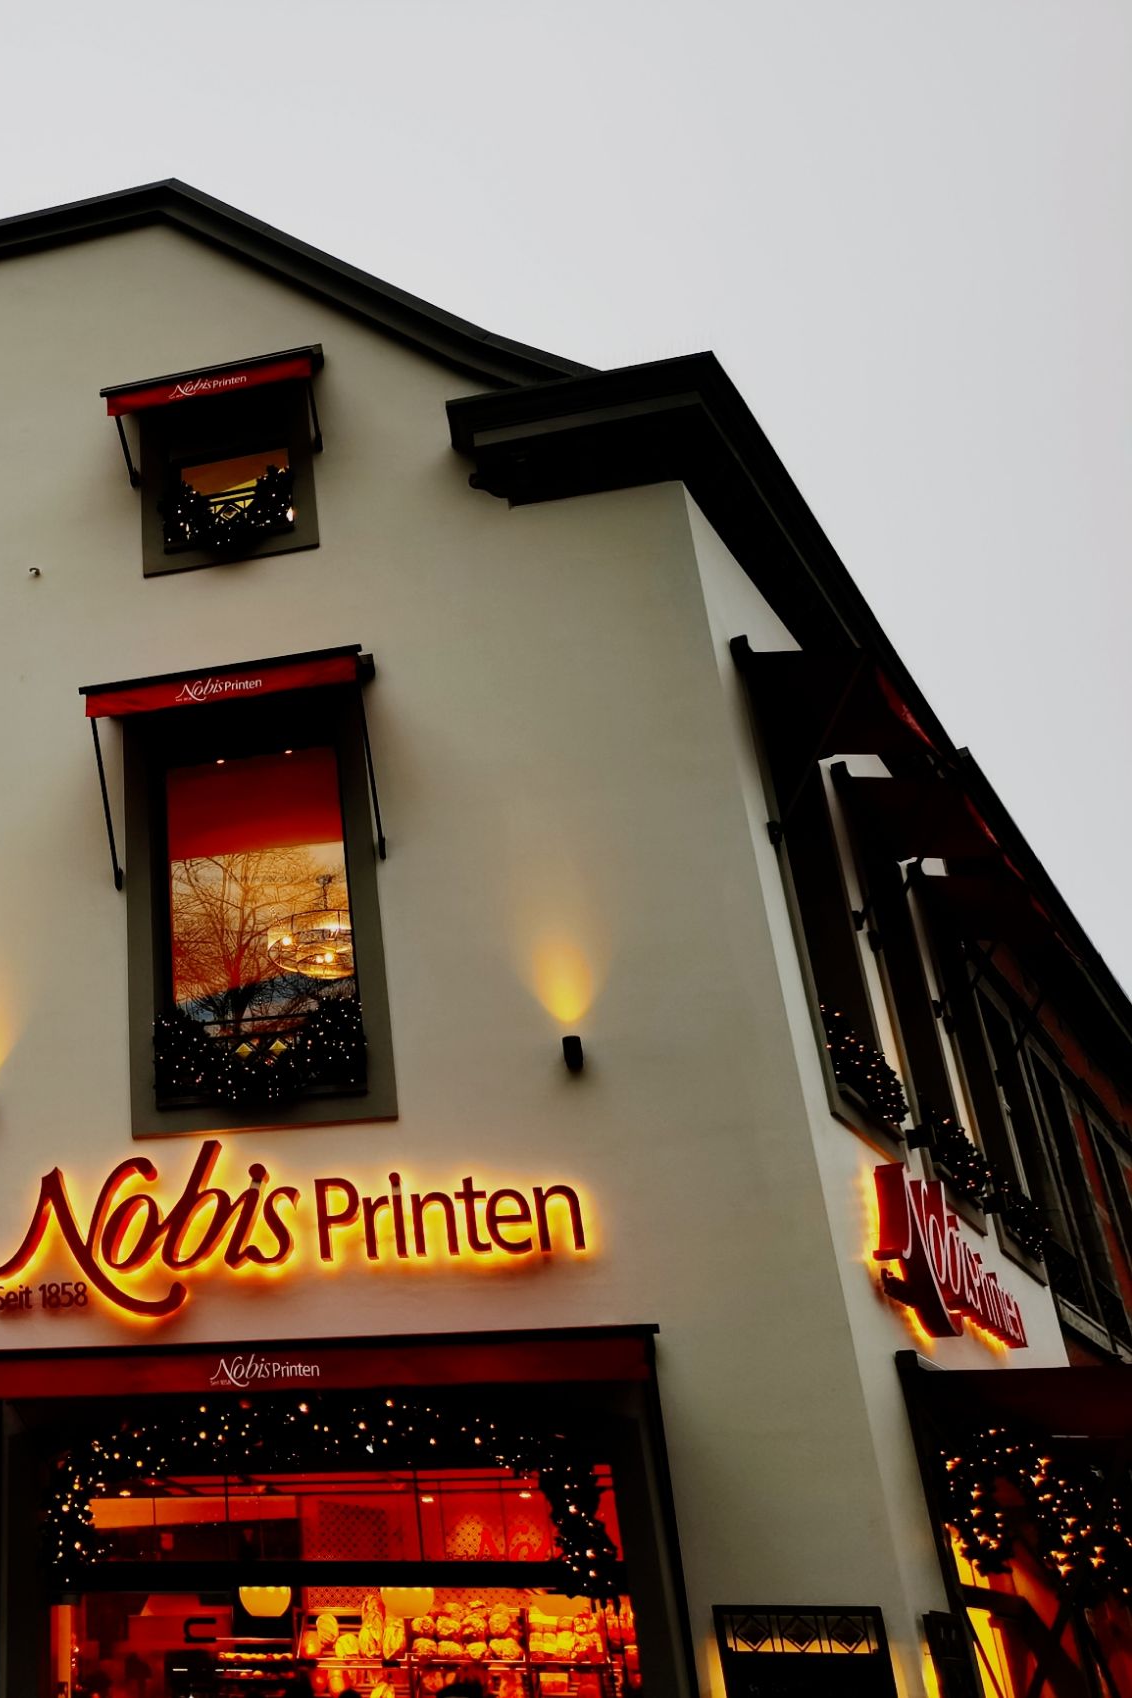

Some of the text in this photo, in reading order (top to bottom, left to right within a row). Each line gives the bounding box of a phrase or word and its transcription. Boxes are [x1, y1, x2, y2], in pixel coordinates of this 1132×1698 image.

[175, 678, 262, 701] Nobis Printen
[314, 1171, 587, 1262] Printen
[38, 1281, 88, 1309] 1858
[209, 1353, 320, 1387] Nobis Printen
